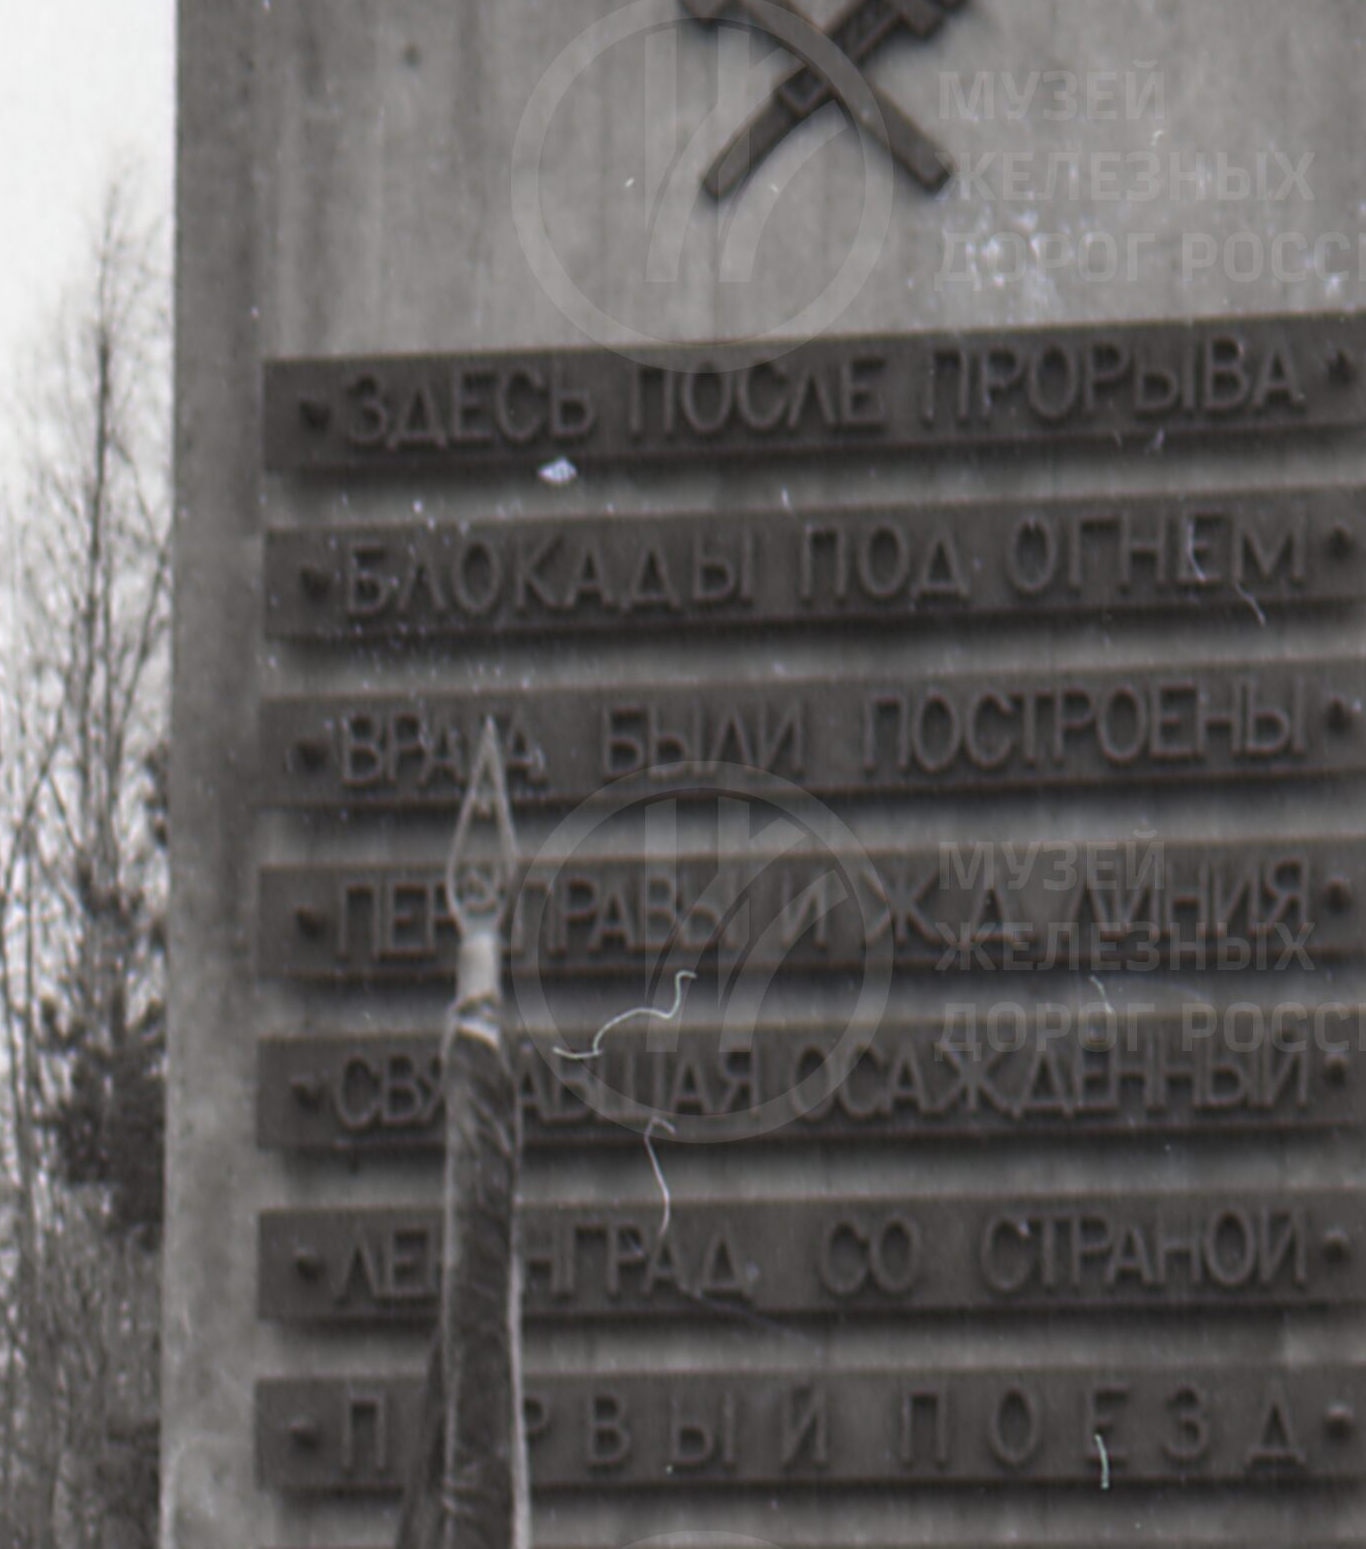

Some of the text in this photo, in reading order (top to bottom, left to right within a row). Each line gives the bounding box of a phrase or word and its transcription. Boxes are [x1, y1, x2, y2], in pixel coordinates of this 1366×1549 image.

[349, 335, 1307, 450] ЗДЕСЬ ПОСЛЕ ПРОРЫВА
[346, 513, 1307, 617] БЛОКАДЫ ПОД ОГНЕМ
[601, 701, 805, 779] БЫЛИ
[858, 683, 1307, 773] ПОСТРОЕНЫ
[337, 866, 738, 961] ПЕРПРАВЫ
[779, 866, 828, 951] И
[1065, 853, 1311, 938] ЛИНИЯ
[333, 1048, 760, 1131] СВЯАВШАЯ
[817, 1216, 921, 1296] СО
[899, 1379, 1308, 1478] ПОЕЗД
